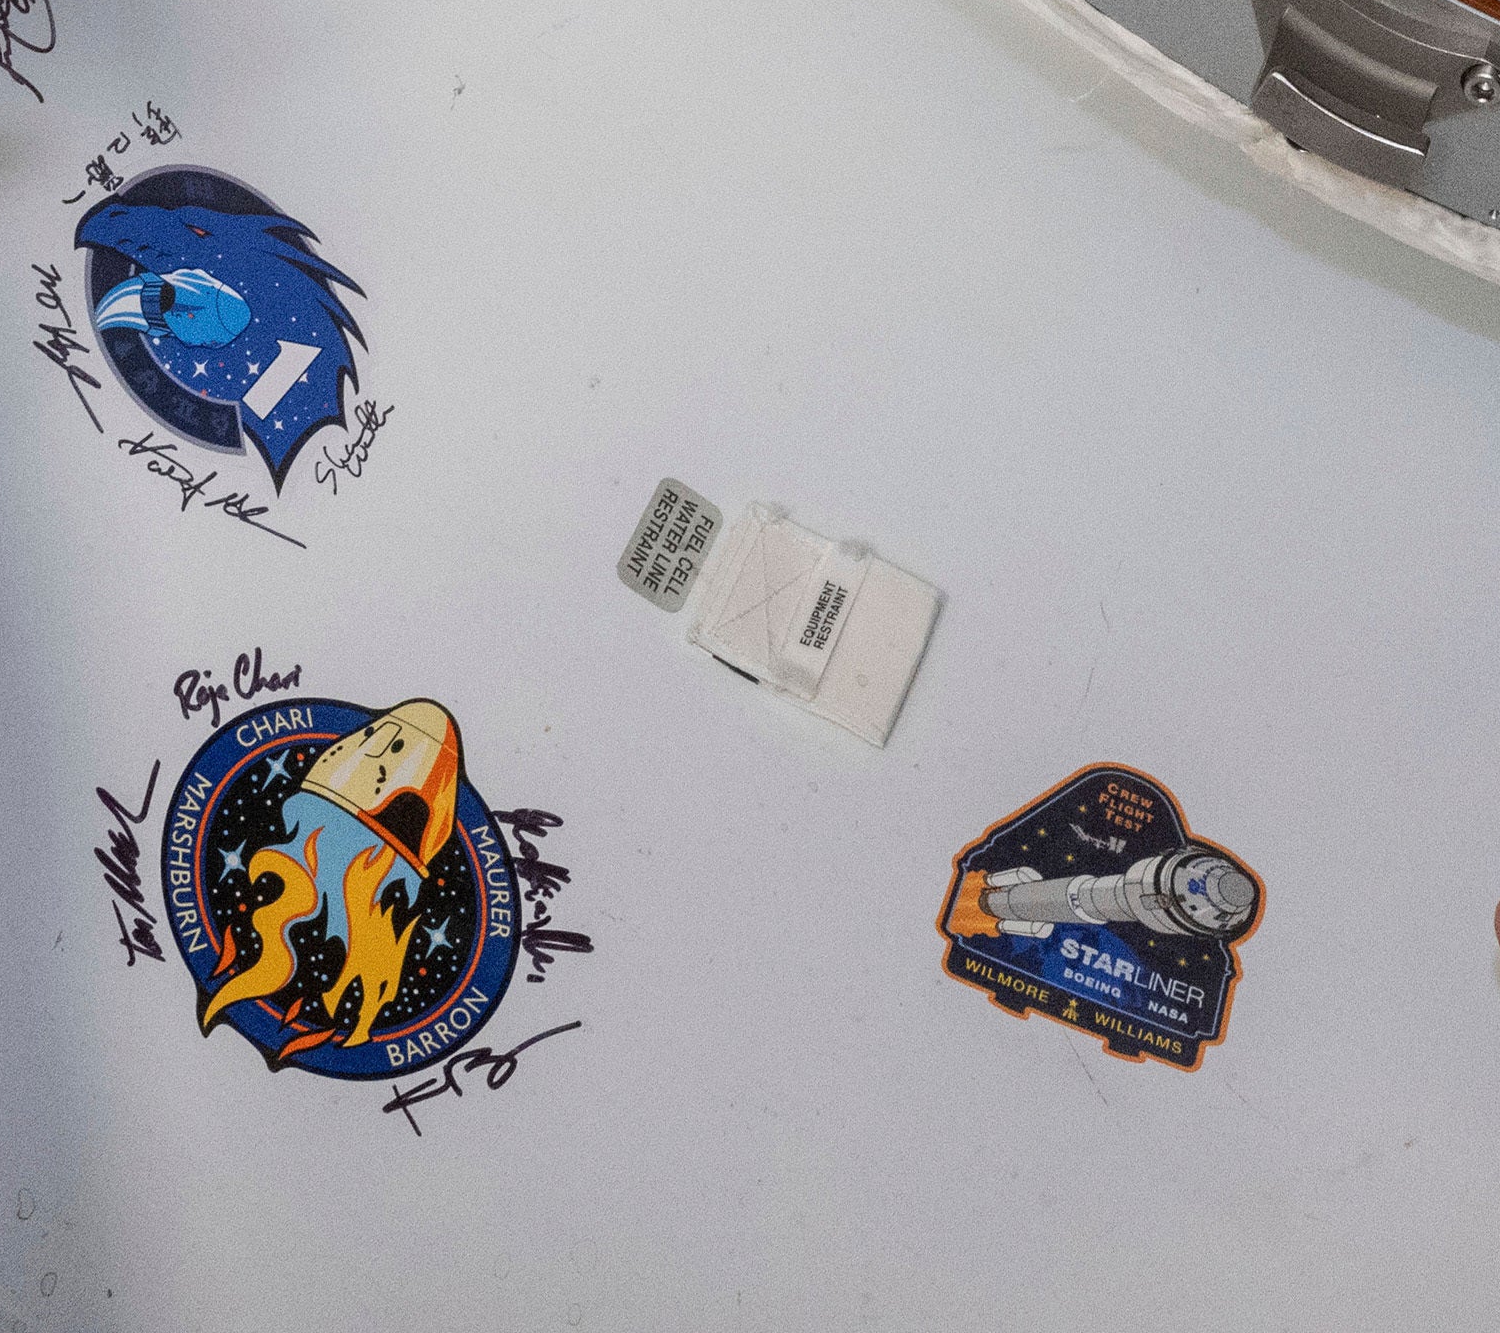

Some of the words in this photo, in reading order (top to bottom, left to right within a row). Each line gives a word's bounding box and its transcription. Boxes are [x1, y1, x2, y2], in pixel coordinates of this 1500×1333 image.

[627, 487, 678, 577] RESTRAINT
[662, 499, 698, 555] WATER
[684, 514, 714, 560] FUEL
[642, 552, 671, 593] LINE
[664, 556, 694, 596] CELL
[799, 579, 837, 647] EQUIPMENT
[812, 585, 849, 651] RESTRAINT
[236, 707, 314, 749] CHARI
[165, 771, 213, 955] MARSHBURN
[471, 824, 511, 939] MAURER
[964, 957, 1051, 1004] WILMORE
[1094, 1011, 1183, 1054] WILLIAMS
[1059, 937, 1206, 1009] STARLINER
[1062, 968, 1122, 999] BOEING
[1148, 1000, 1190, 1025] NASA
[386, 986, 490, 1068] BARRON
